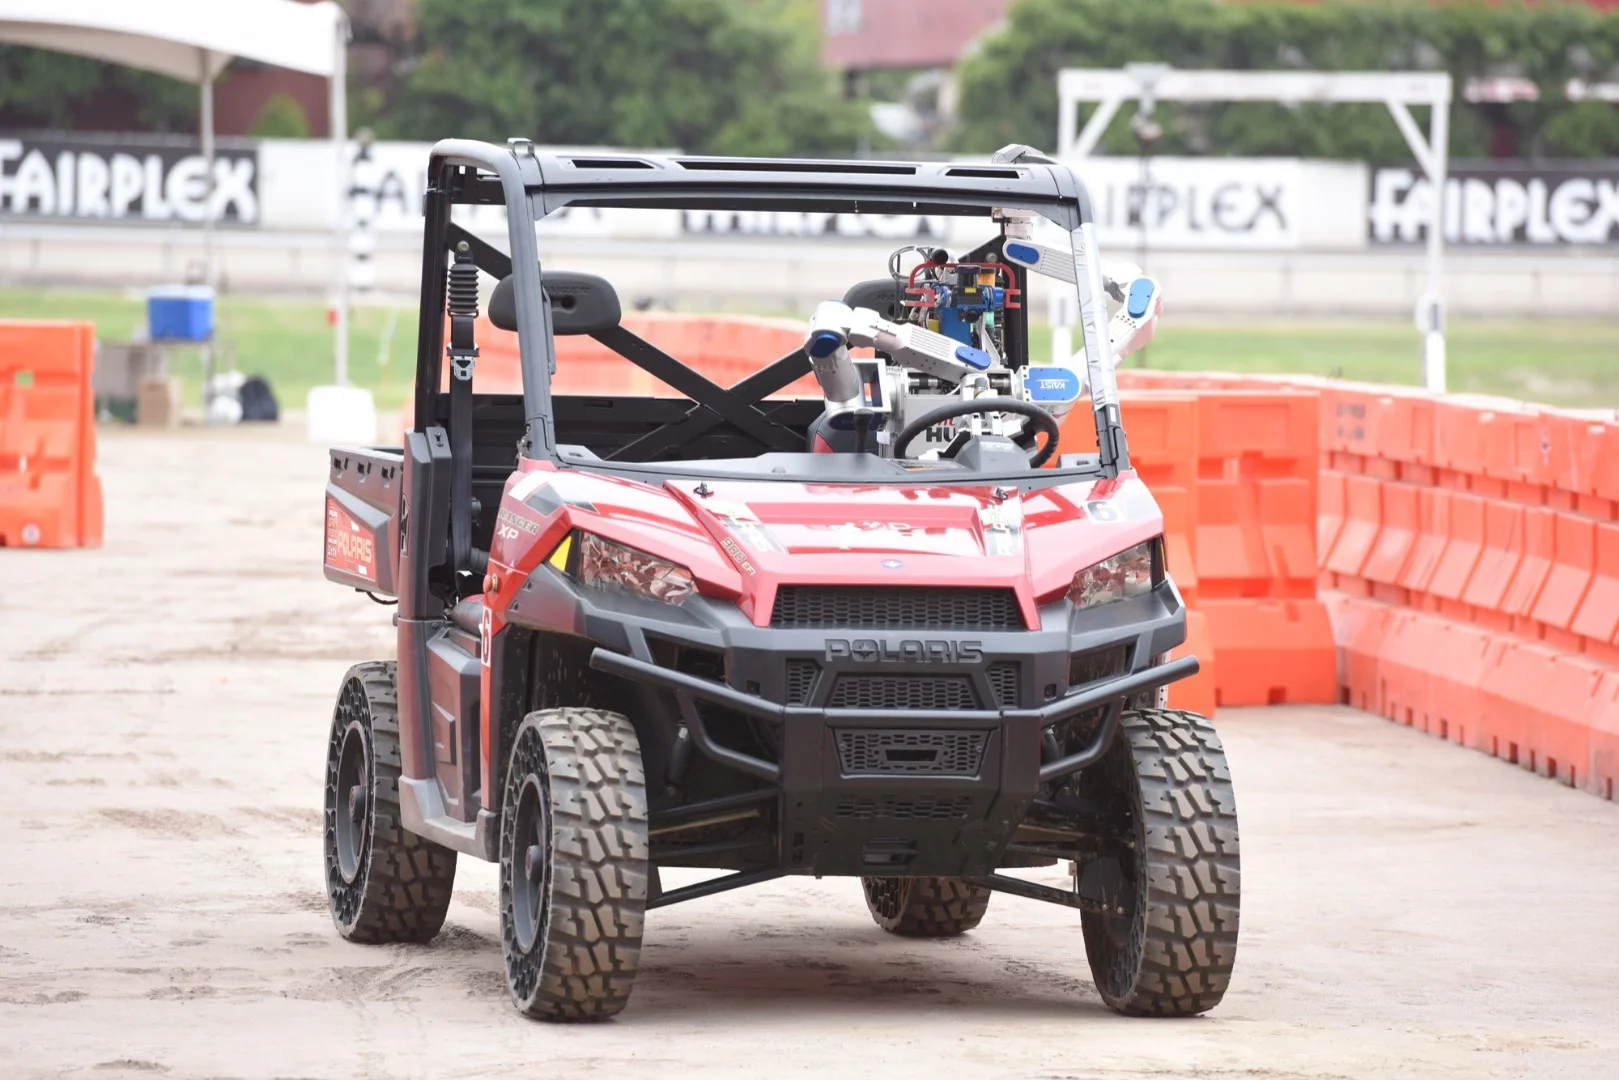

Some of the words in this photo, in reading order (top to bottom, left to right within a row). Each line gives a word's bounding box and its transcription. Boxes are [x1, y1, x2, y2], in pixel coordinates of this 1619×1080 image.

[497, 524, 519, 539] XP
[499, 508, 540, 535] RANGER
[338, 531, 371, 563] POLARIS
[720, 537, 746, 561] 900
[825, 638, 983, 663] POLARIS
